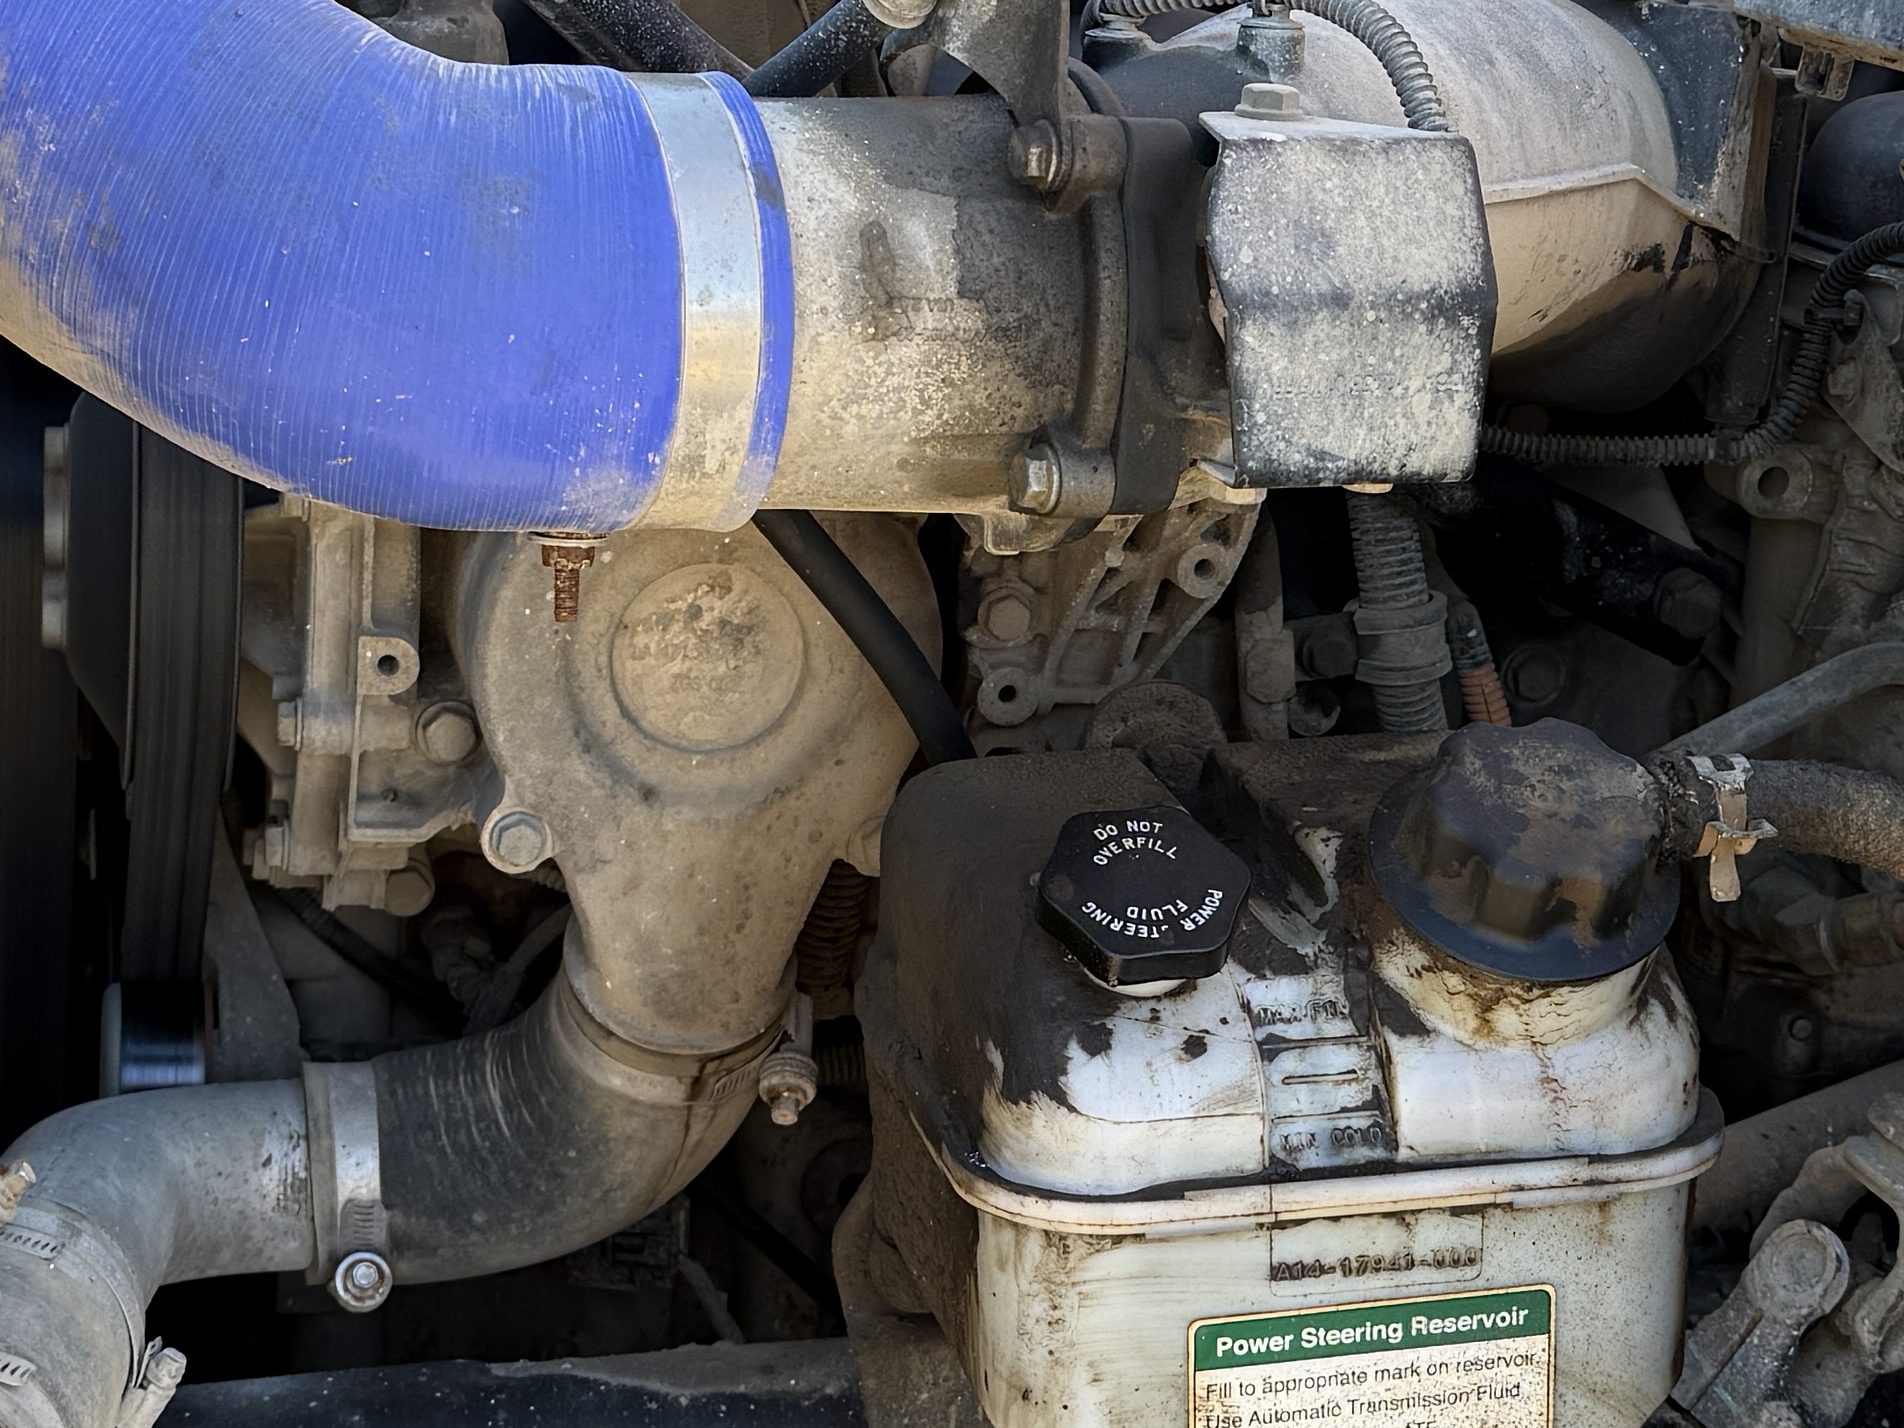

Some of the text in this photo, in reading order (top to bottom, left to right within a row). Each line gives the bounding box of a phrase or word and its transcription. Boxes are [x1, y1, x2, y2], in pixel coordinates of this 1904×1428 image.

[1093, 820, 1164, 841] DO NOT
[1093, 837, 1178, 866] OVERFILL
[1081, 889, 1223, 938] POWER TEERING
[1126, 899, 1189, 921] FLUID
[1216, 1306, 1529, 1358] Power Steering Reservoir
[1206, 1382, 1233, 1402] Fill
[1238, 1381, 1256, 1398] to
[1261, 1369, 1368, 1397] appropriate
[1374, 1361, 1421, 1383] mark
[1426, 1361, 1449, 1377] on
[1248, 1403, 1342, 1427] Automatic
[1347, 1389, 1471, 1416] Transmission
